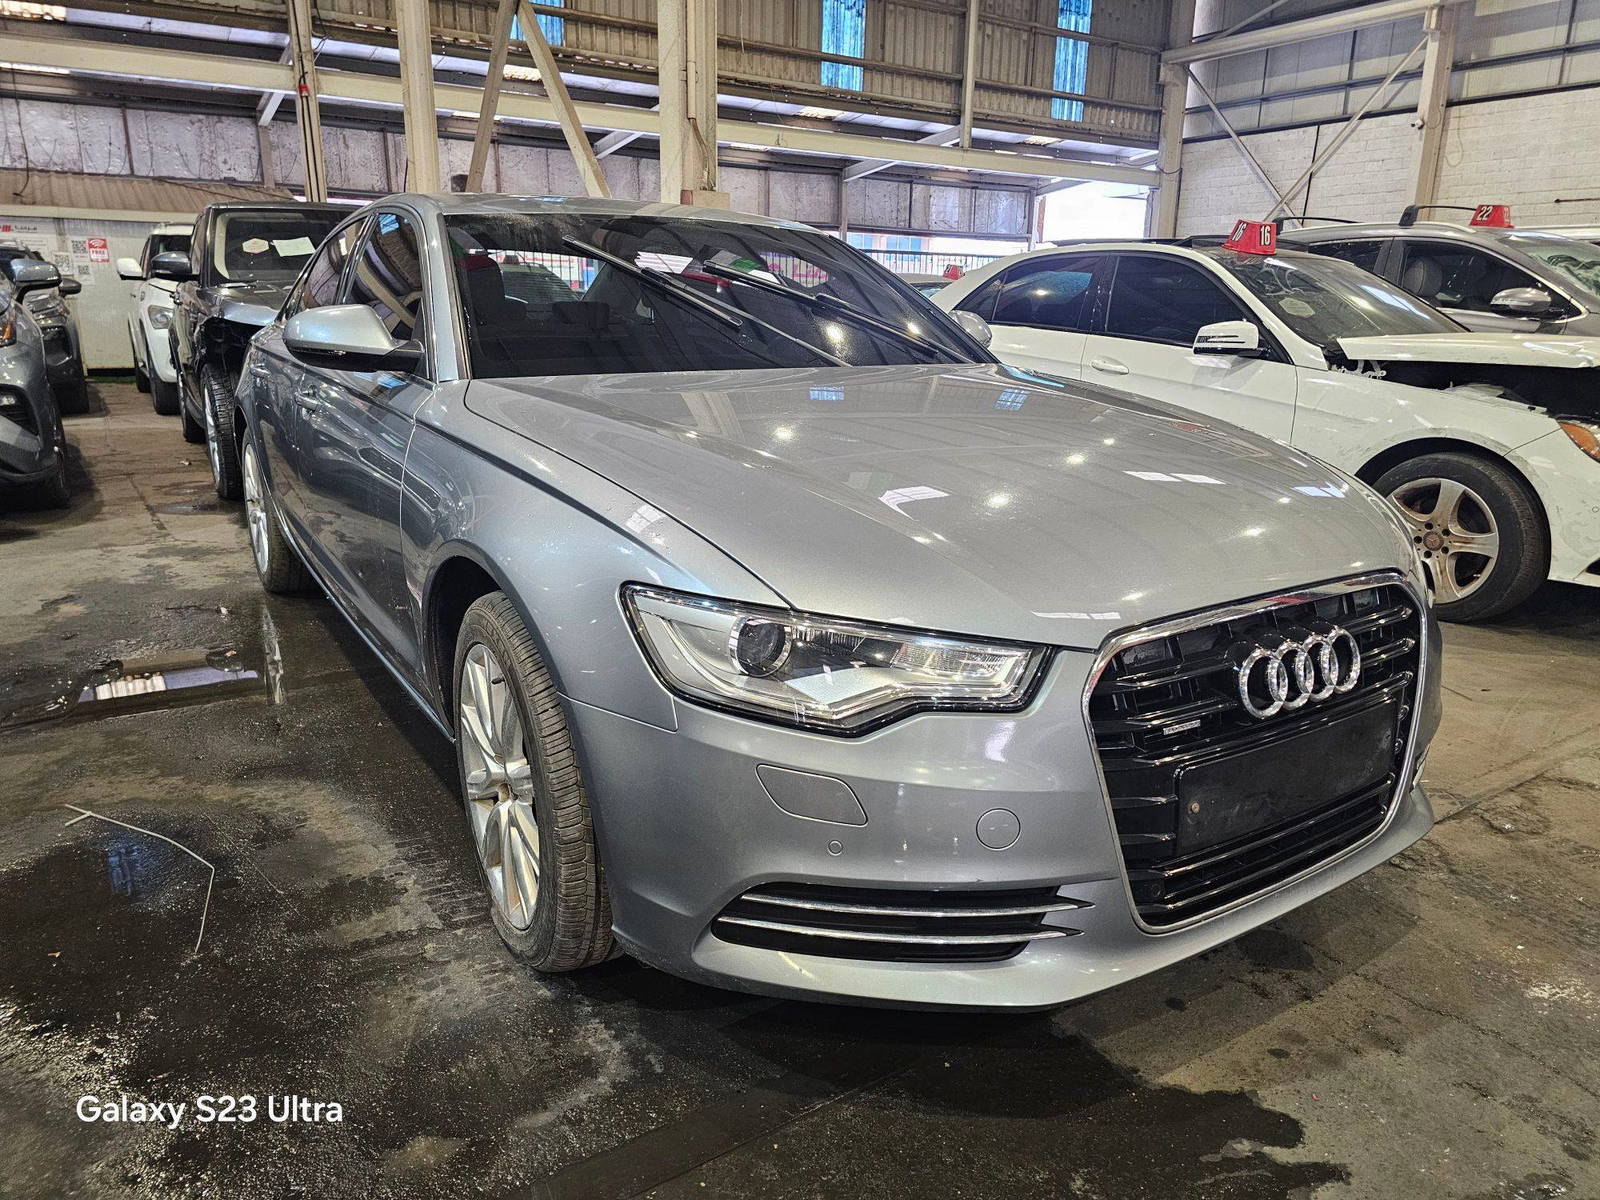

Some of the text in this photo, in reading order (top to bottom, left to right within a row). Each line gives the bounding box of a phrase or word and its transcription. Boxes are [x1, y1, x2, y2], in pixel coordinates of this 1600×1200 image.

[1476, 205, 1494, 221] 22
[1231, 222, 1247, 241] 16
[1260, 224, 1271, 246] 16
